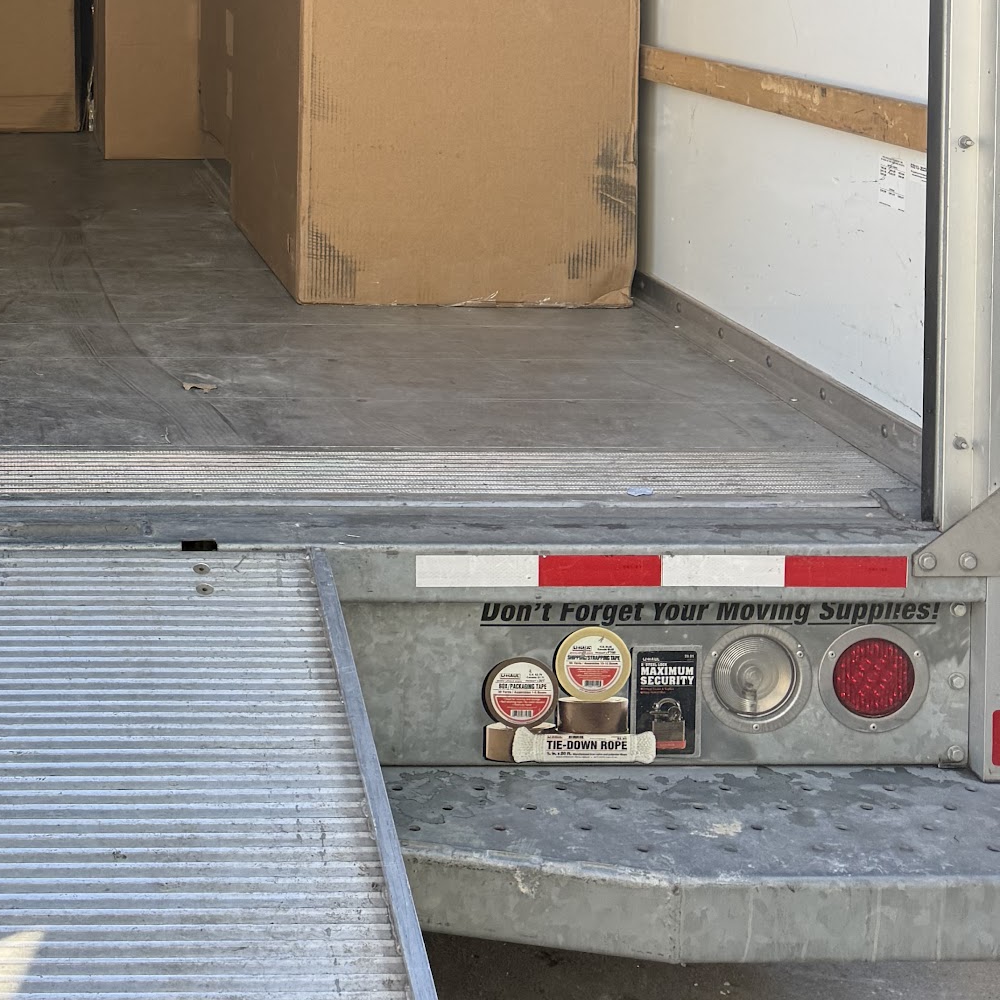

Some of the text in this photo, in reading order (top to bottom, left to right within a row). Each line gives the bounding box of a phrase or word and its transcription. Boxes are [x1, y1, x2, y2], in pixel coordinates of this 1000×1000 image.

[480, 602, 940, 626] Don't Forget Your Moving Supplies!
[641, 667, 694, 676] MAXIMUM
[640, 676, 694, 685] SECURITY
[547, 740, 627, 750] TIE-DOWN ROPE
